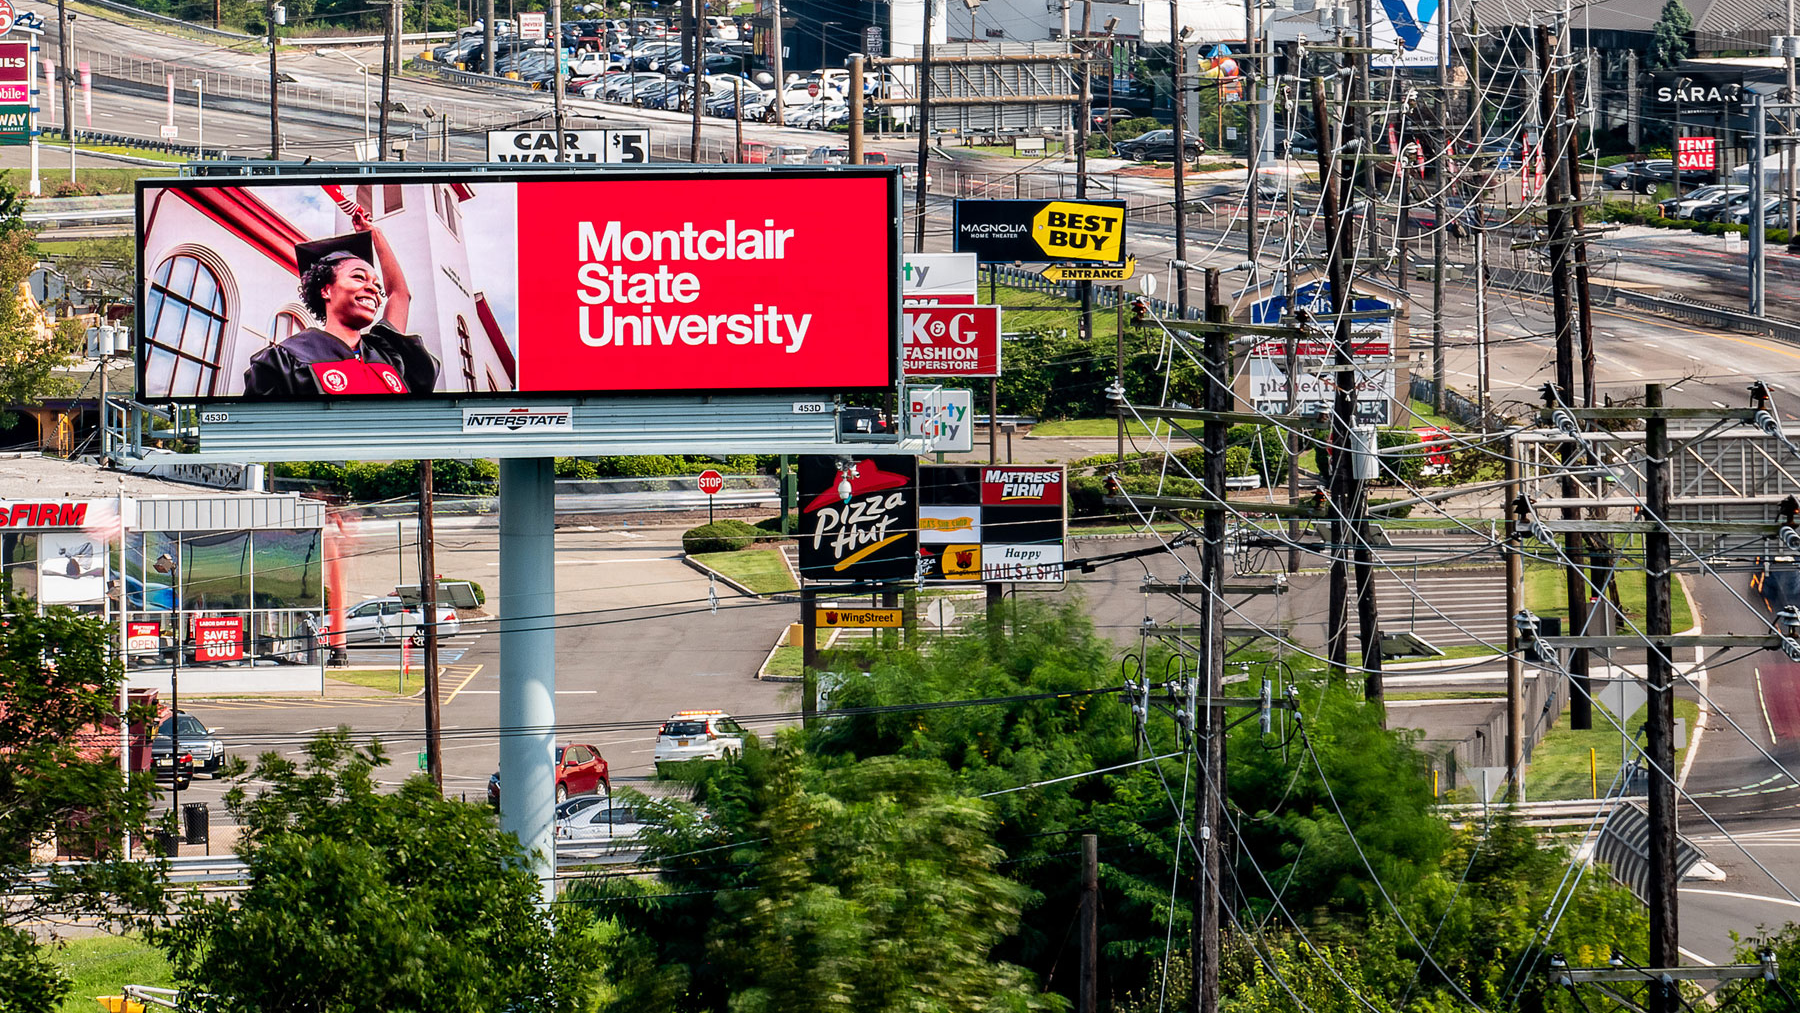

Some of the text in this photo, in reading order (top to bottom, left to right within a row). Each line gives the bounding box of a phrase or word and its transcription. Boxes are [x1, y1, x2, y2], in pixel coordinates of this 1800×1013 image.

[513, 133, 580, 150] CAR
[1678, 139, 1715, 153] TENT
[1678, 154, 1715, 168] SALE
[960, 223, 1028, 233] MAGNOLIA
[1047, 210, 1118, 233] BEST
[578, 218, 795, 262] Montclair
[1048, 230, 1111, 252] BUY
[902, 261, 930, 288] ty
[1061, 269, 1124, 279] ENTRANCE
[576, 263, 701, 305] State
[578, 303, 813, 354] University
[902, 312, 979, 345] K&G
[902, 347, 979, 360] FASHION
[902, 360, 979, 370] SUPERSTORE
[1259, 378, 1318, 397] plaet
[798, 404, 822, 412] 453D
[911, 401, 967, 422] Party
[1284, 402, 1316, 415] HE
[204, 413, 228, 422] 453D
[920, 419, 960, 441] City
[700, 477, 722, 488] STOP
[984, 469, 1060, 484] MATTRESS
[1002, 483, 1046, 497] FIRM
[813, 491, 907, 550] Pizza
[830, 514, 899, 559] Hut
[1004, 547, 1042, 560] Happy
[919, 558, 936, 566] zza
[984, 562, 1061, 580] NAILS & SPA
[840, 612, 894, 623] WingStreet
[203, 630, 229, 640] SAVE
[131, 639, 157, 649] OPEN
